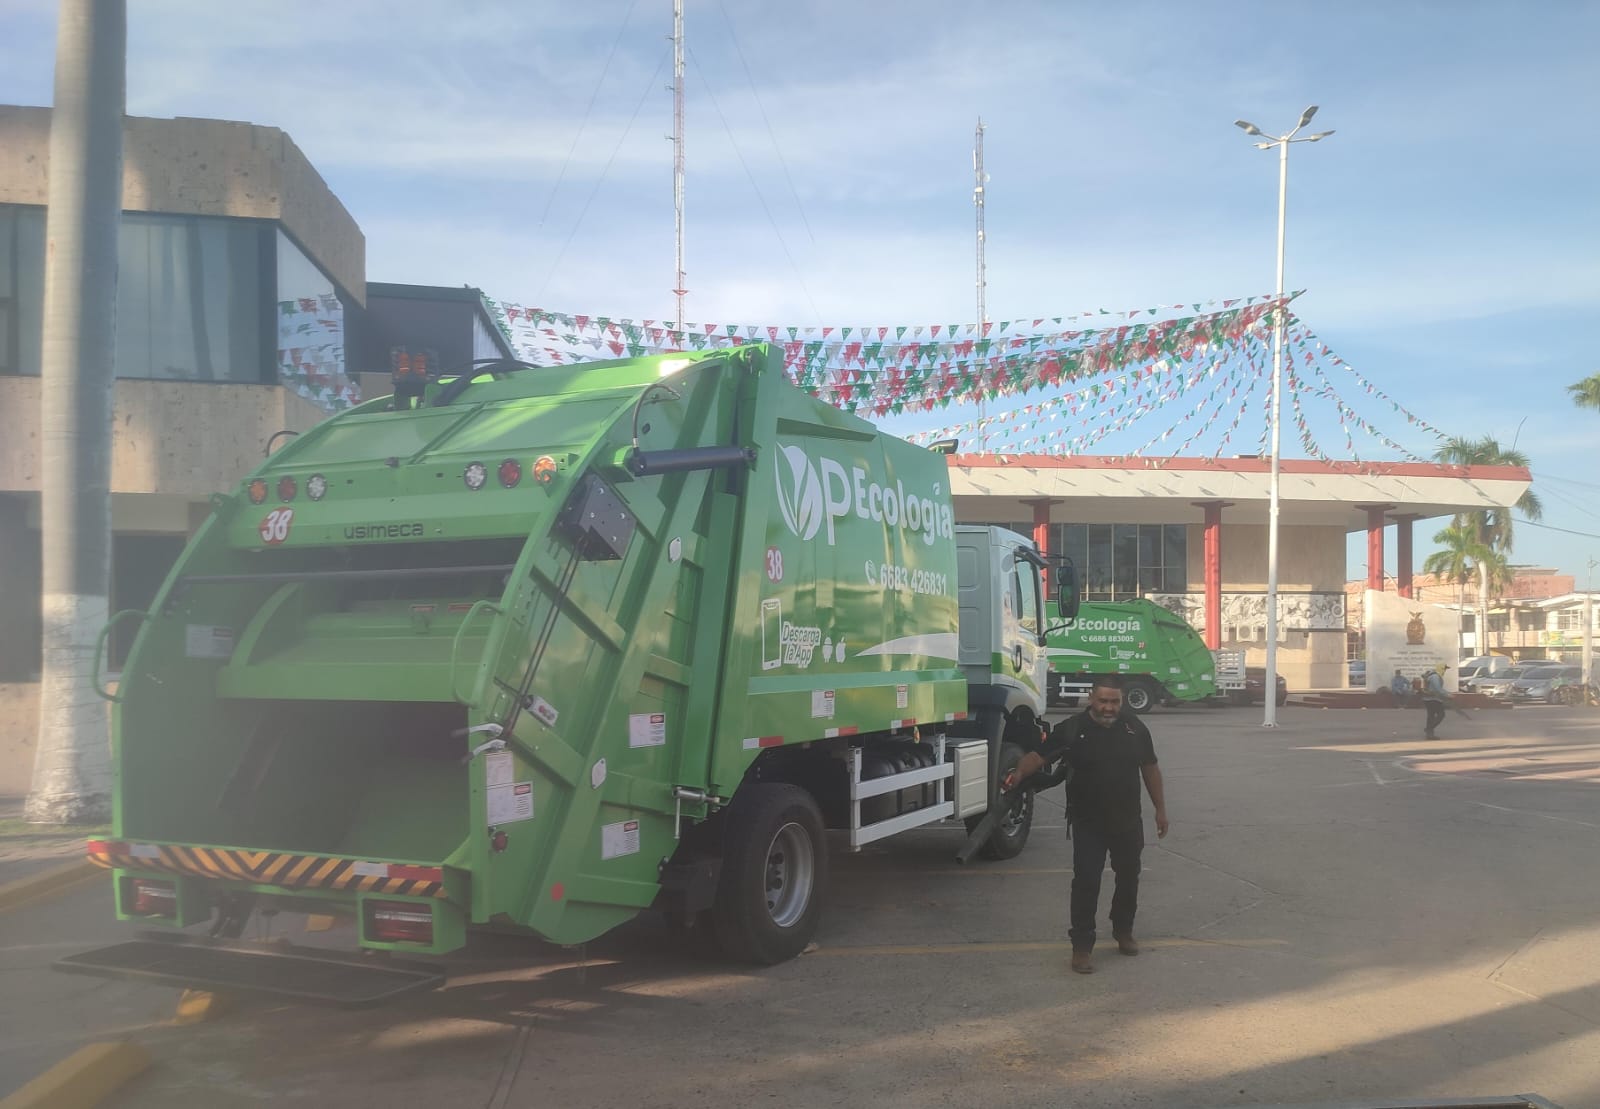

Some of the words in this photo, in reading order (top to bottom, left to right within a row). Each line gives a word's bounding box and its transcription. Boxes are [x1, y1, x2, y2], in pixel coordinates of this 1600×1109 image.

[261, 508, 293, 541] 38
[344, 521, 424, 540] usimeca
[767, 549, 783, 580] 38
[880, 563, 908, 591] 6683
[911, 568, 947, 597] 426831
[782, 624, 821, 647] Descarga
[795, 646, 812, 665] App
